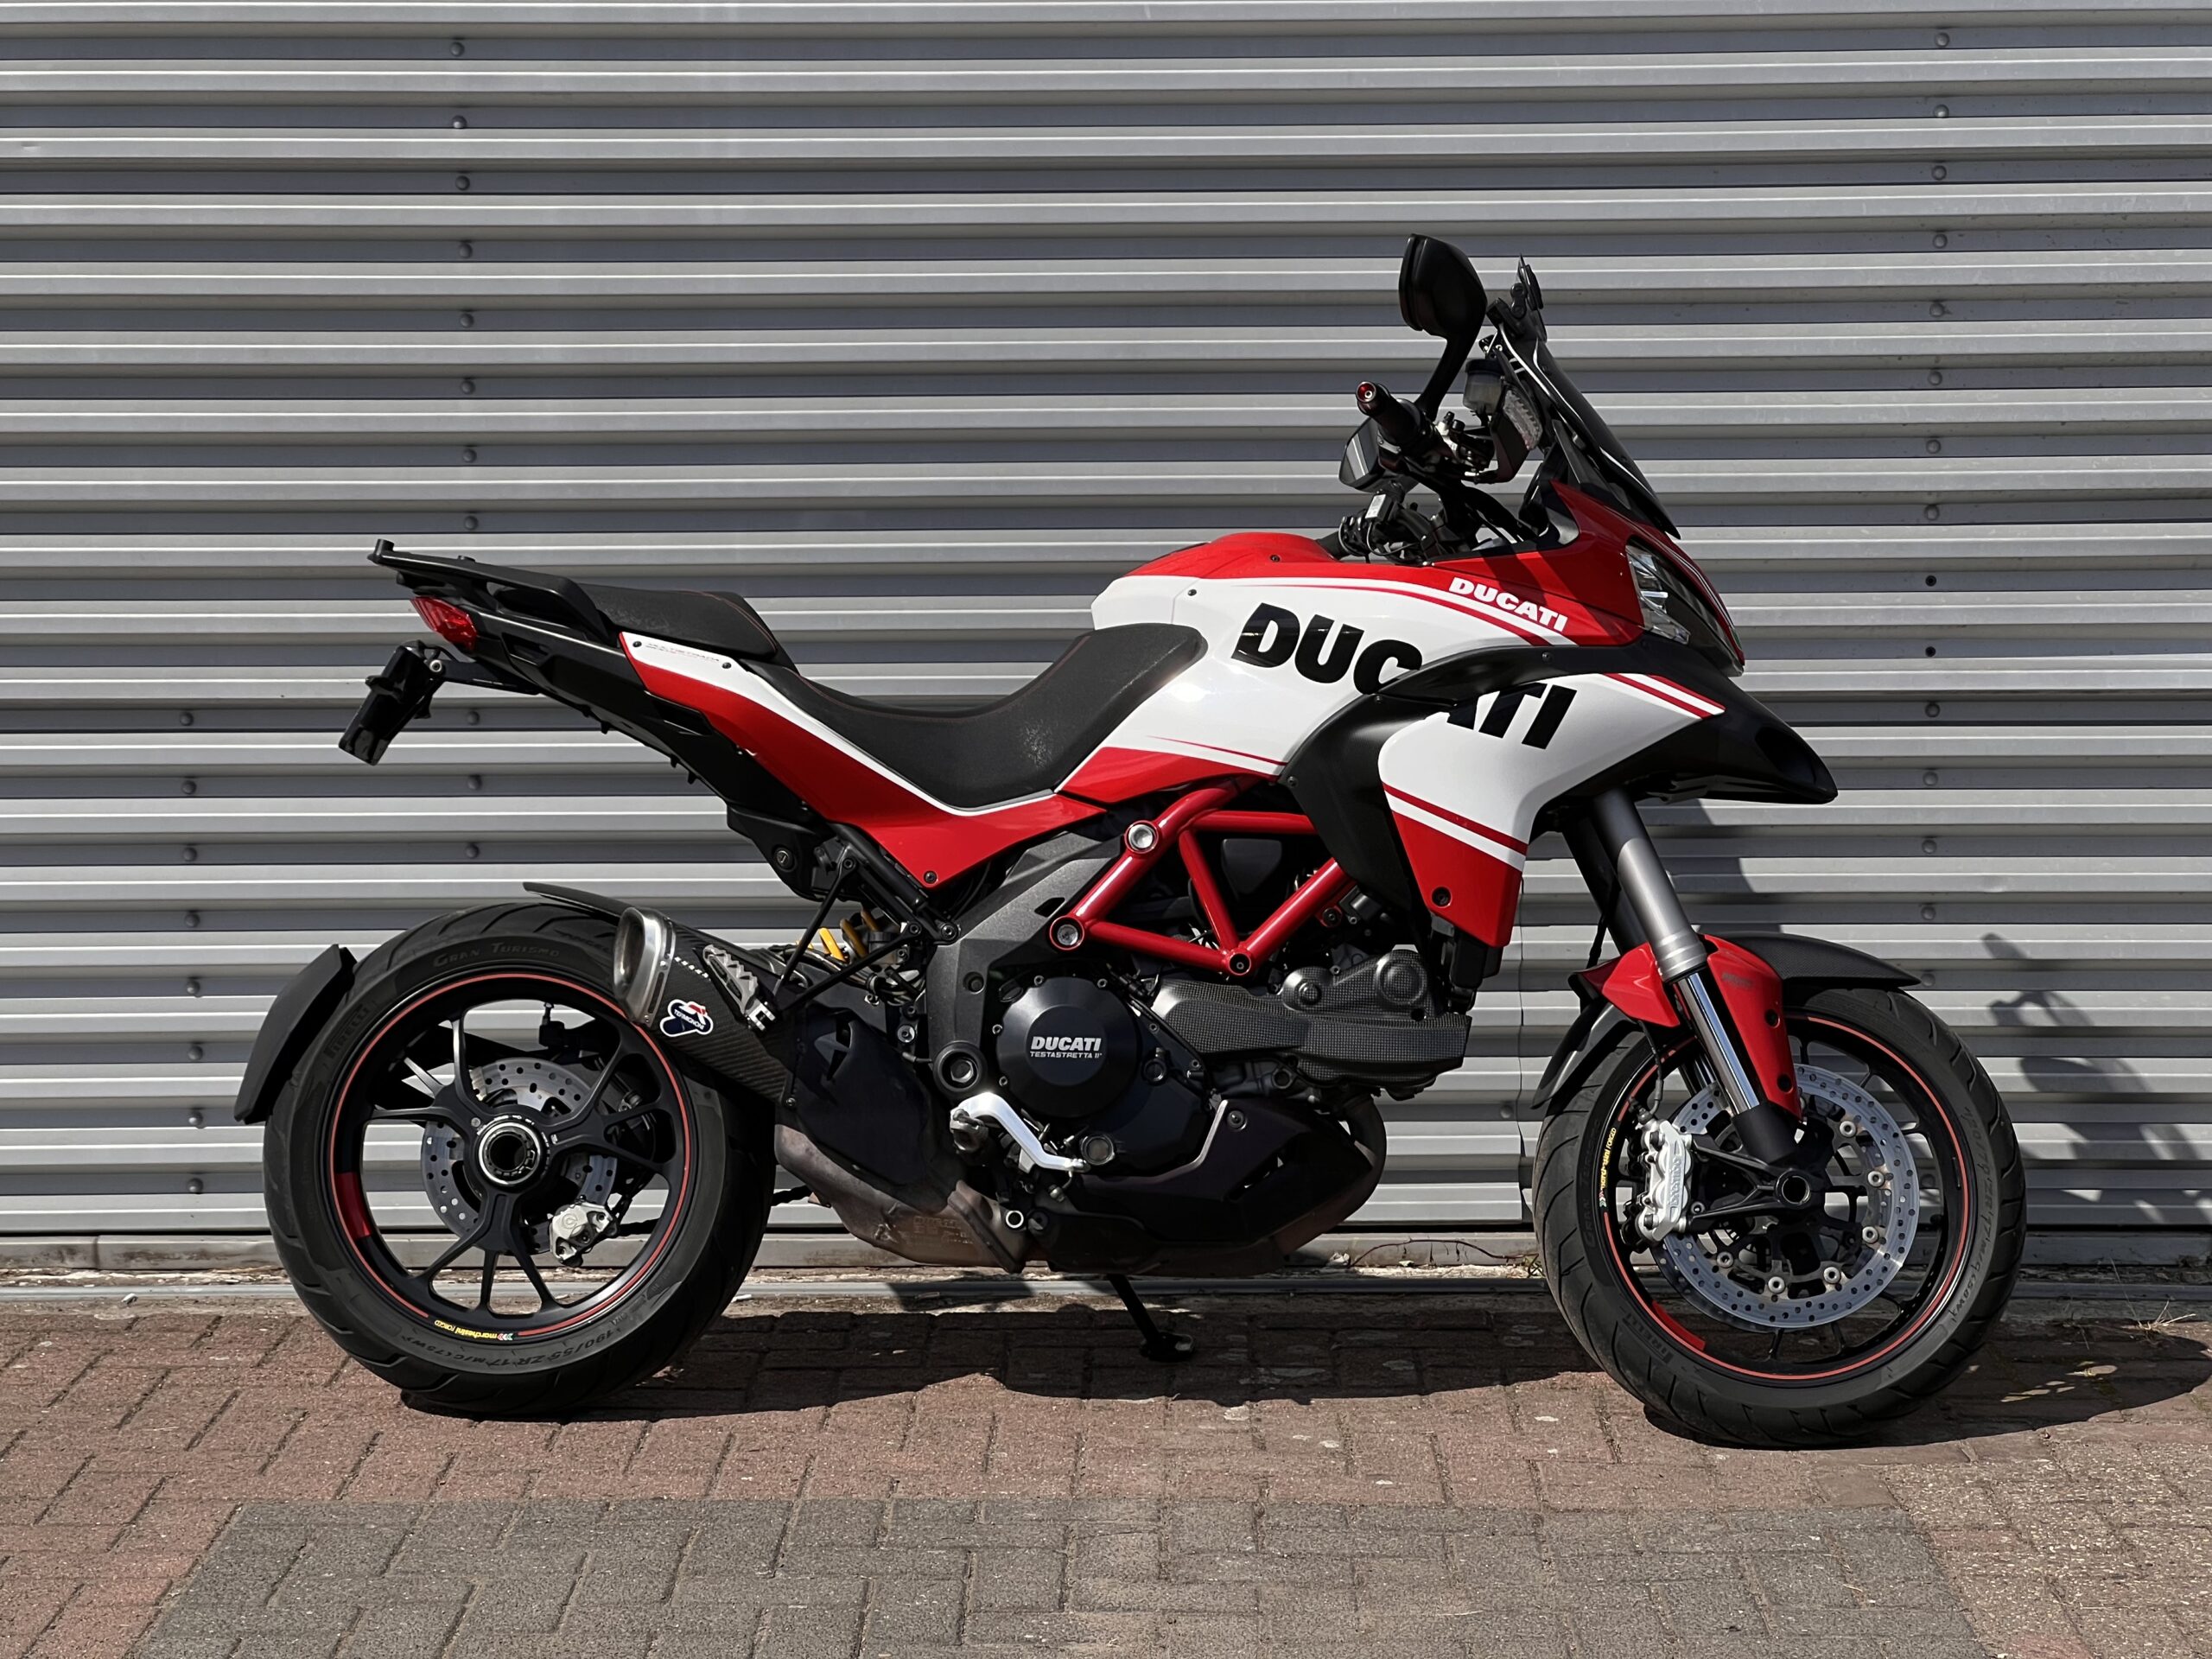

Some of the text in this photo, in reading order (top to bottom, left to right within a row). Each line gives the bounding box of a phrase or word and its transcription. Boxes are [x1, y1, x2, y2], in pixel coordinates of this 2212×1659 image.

[1448, 576, 1568, 632] DUCATI
[1031, 1036, 1102, 1052] DUCATI
[1029, 1051, 1093, 1059] TESTASTRETTA
